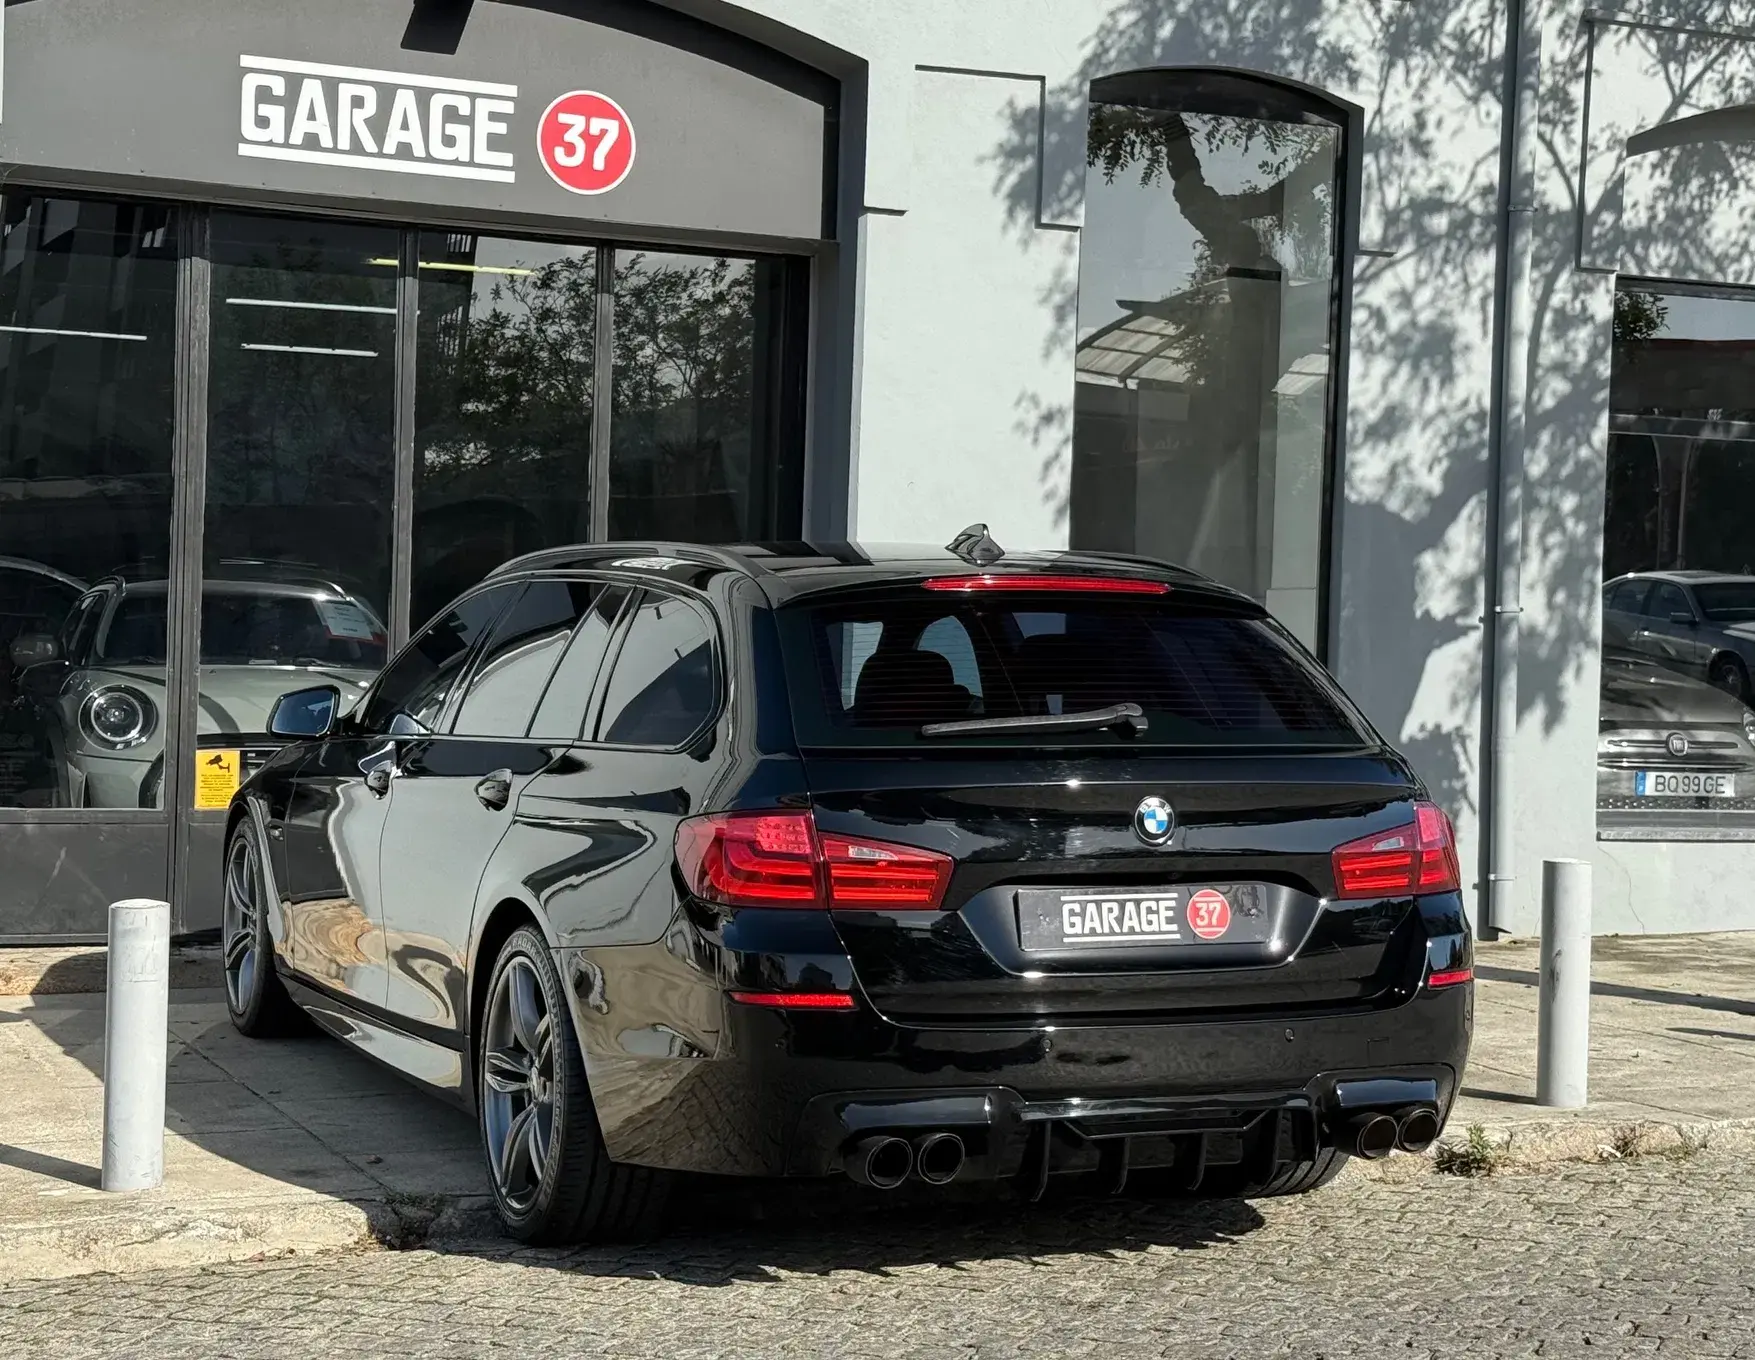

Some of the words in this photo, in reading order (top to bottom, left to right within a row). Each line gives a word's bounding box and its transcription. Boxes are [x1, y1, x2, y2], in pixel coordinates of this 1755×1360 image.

[240, 71, 515, 168] GARAGE
[554, 112, 620, 171] 37
[1682, 776, 1701, 794] 99
[1703, 776, 1726, 794] GE
[1062, 900, 1178, 935] GARAGE
[1195, 902, 1222, 927] 37
